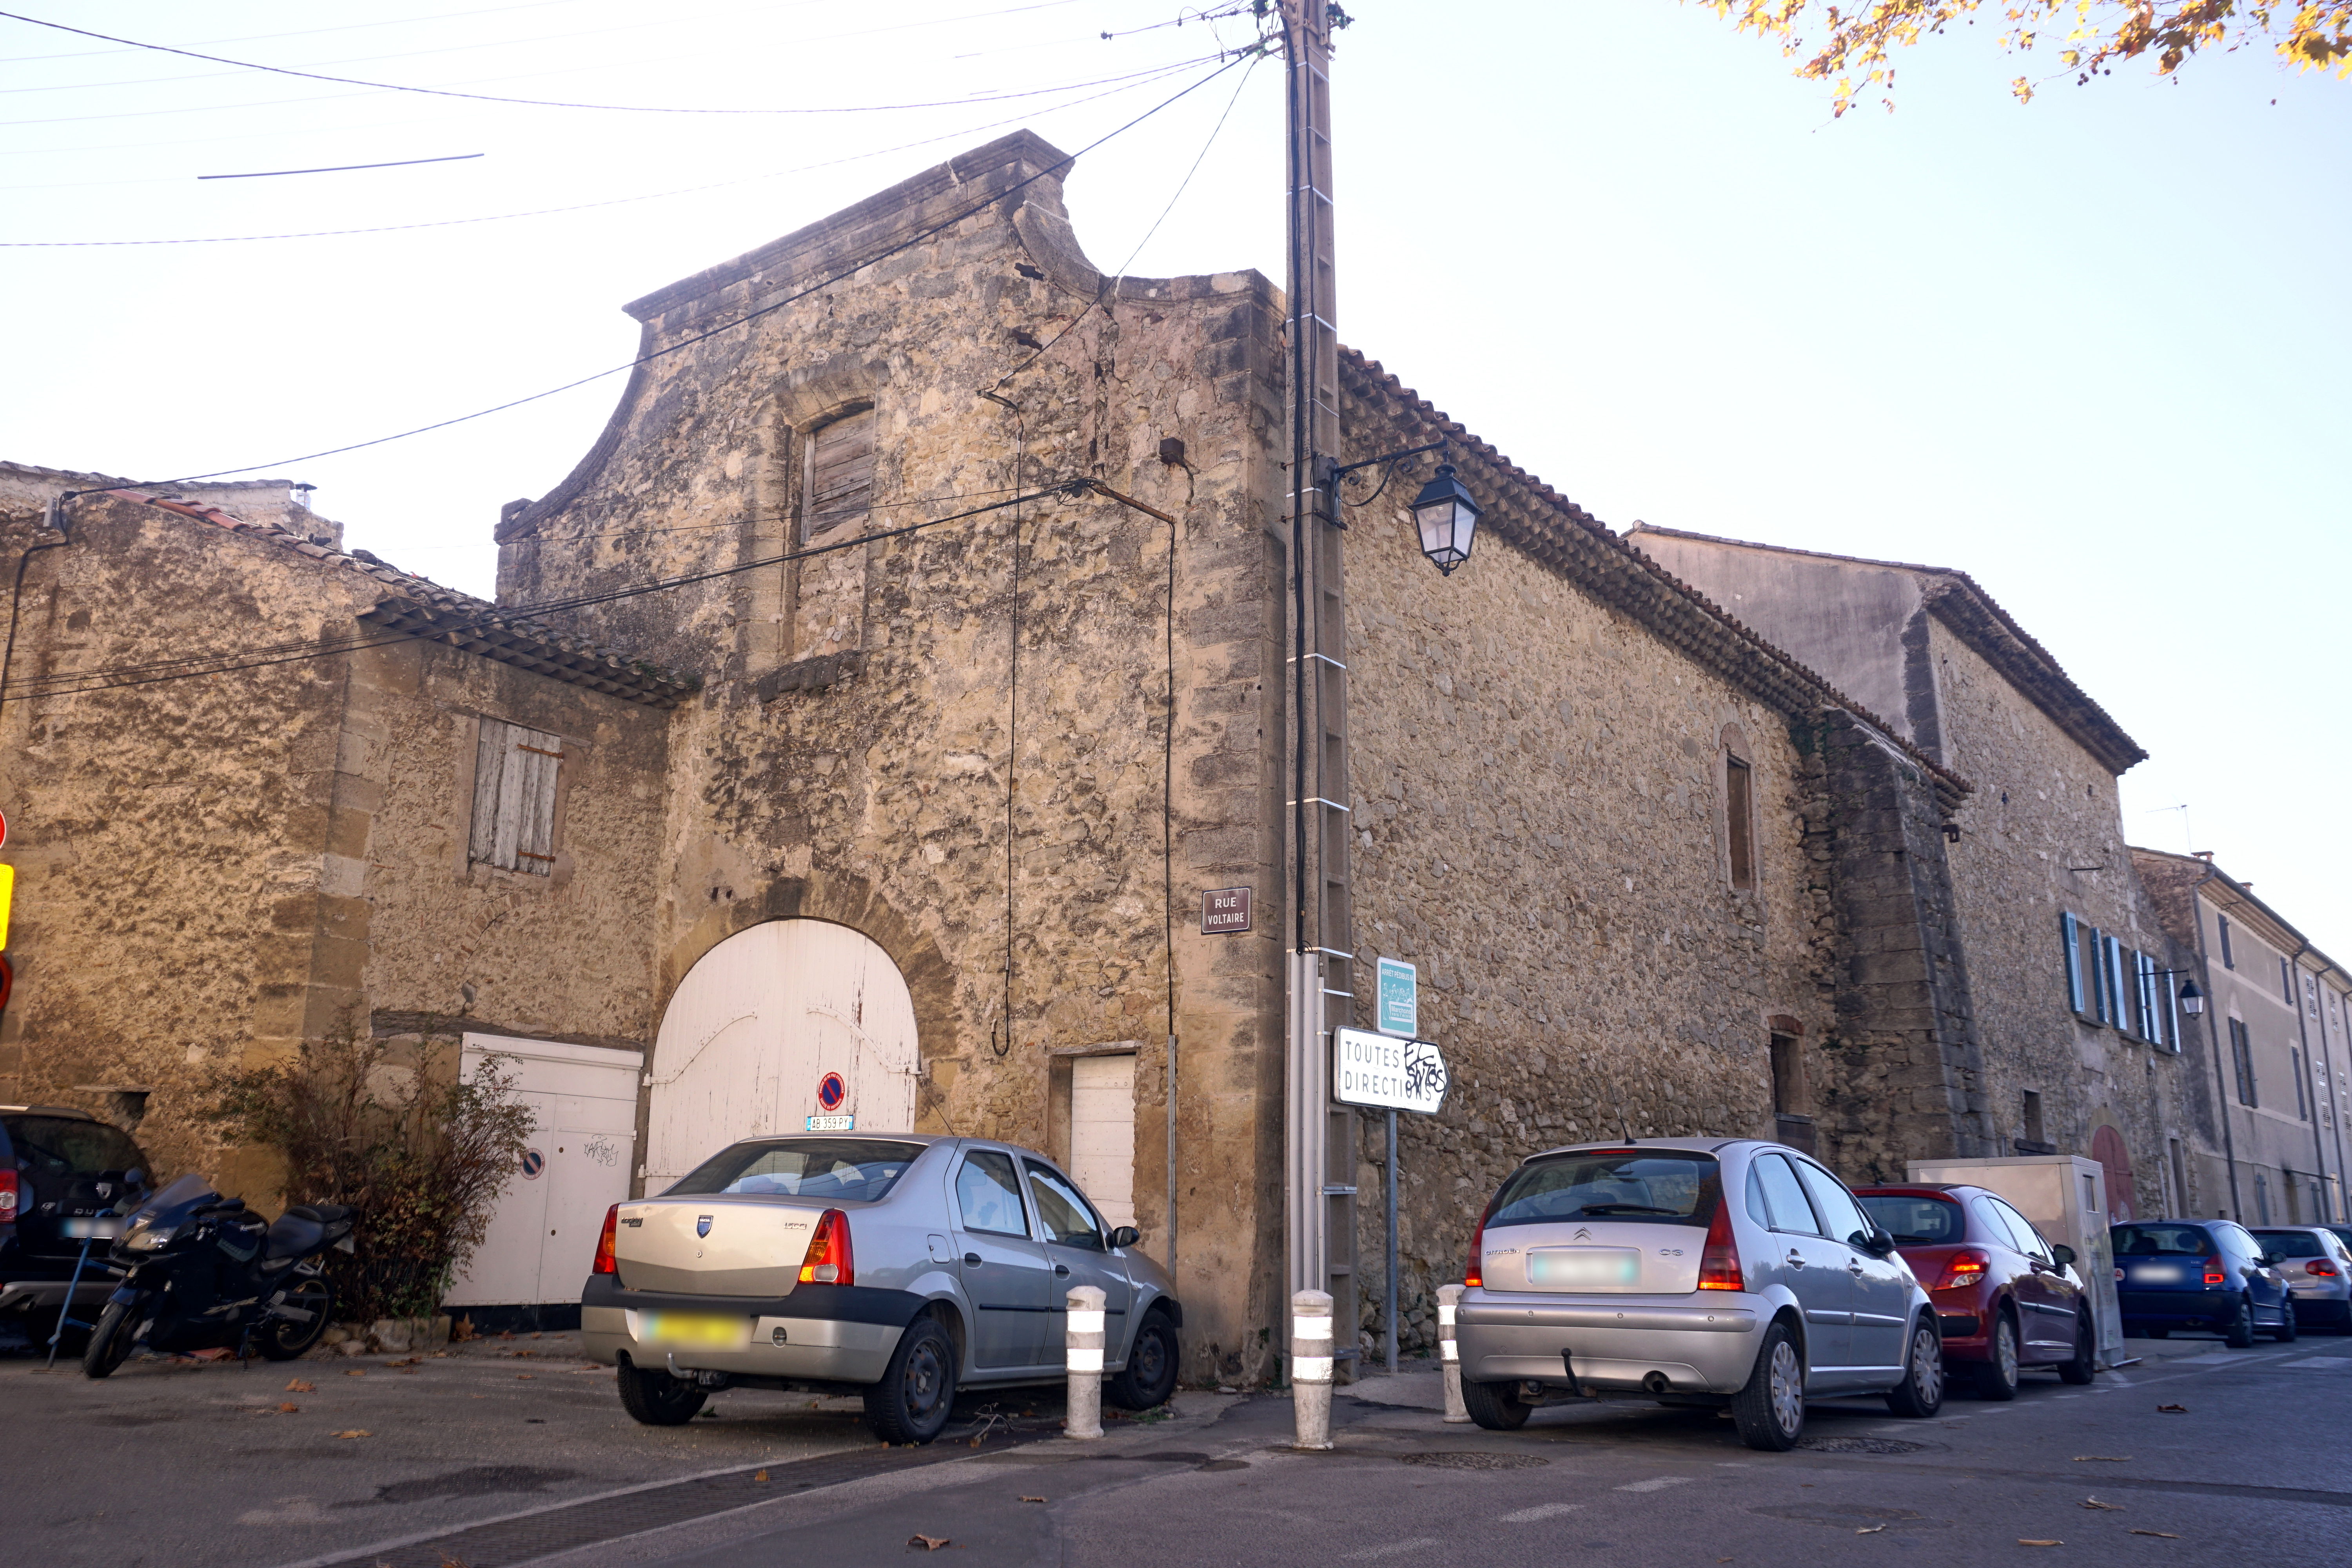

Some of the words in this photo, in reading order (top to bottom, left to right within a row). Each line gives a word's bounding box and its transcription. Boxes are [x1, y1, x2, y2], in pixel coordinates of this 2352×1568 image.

[1215, 897, 1237, 909] RUE
[1208, 912, 1244, 925] VOLTAIRE
[1394, 970, 1410, 981] PÉDIBUS
[1391, 1005, 1411, 1014] Marchons
[1345, 1041, 1399, 1068] TOUTES
[1345, 1070, 1431, 1102] DIRECTIONS
[1659, 1248, 1684, 1256] C3
